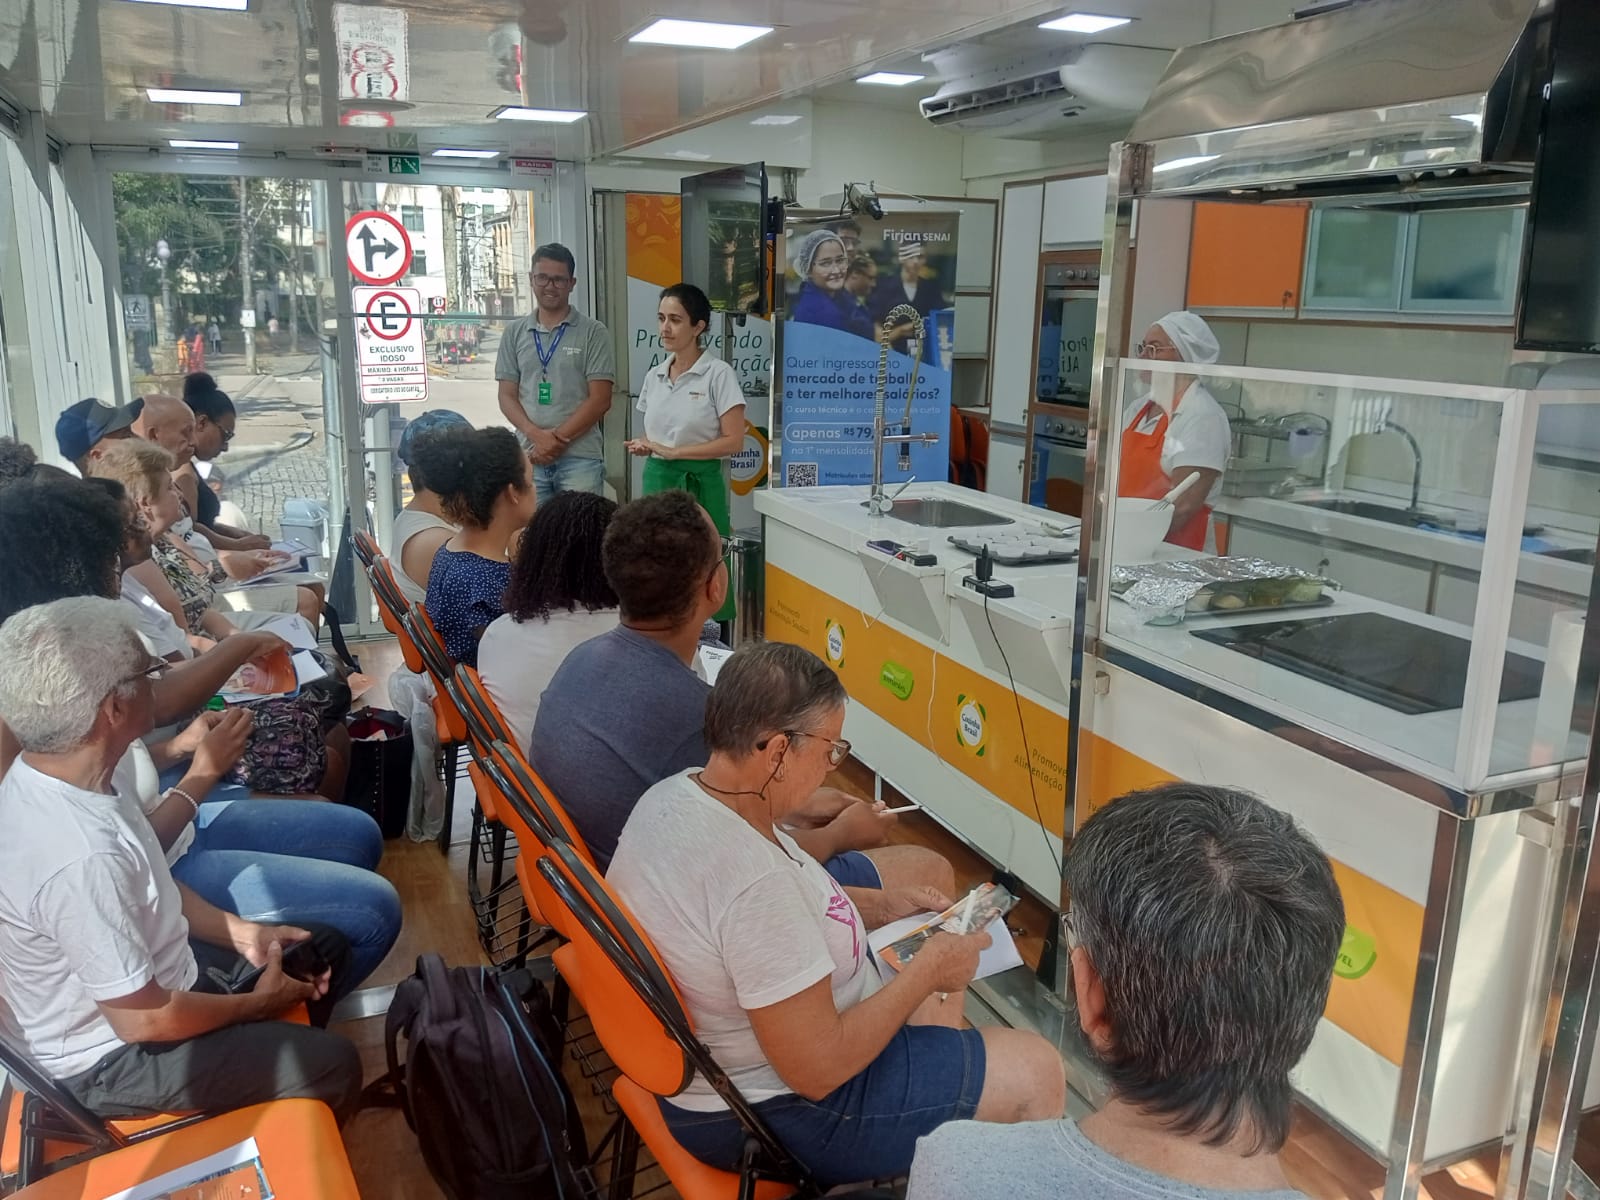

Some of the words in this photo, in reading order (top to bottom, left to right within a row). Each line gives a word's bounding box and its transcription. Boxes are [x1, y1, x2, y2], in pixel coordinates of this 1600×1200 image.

[883, 229, 921, 243] Firjan
[922, 232, 951, 241] SENAI
[380, 302, 398, 330] E
[369, 345, 414, 353] EXCLUSIVO
[380, 354, 405, 362] IDOSO
[786, 356, 818, 369] Quer
[786, 372, 845, 384] mercado
[849, 372, 865, 384] de
[786, 390, 793, 399] e
[797, 388, 816, 399] ter
[792, 429, 841, 440] apenas
[844, 427, 855, 436] R$
[730, 460, 755, 469] Brasil
[961, 713, 981, 731] Cozinha
[964, 723, 978, 738] Brasil
